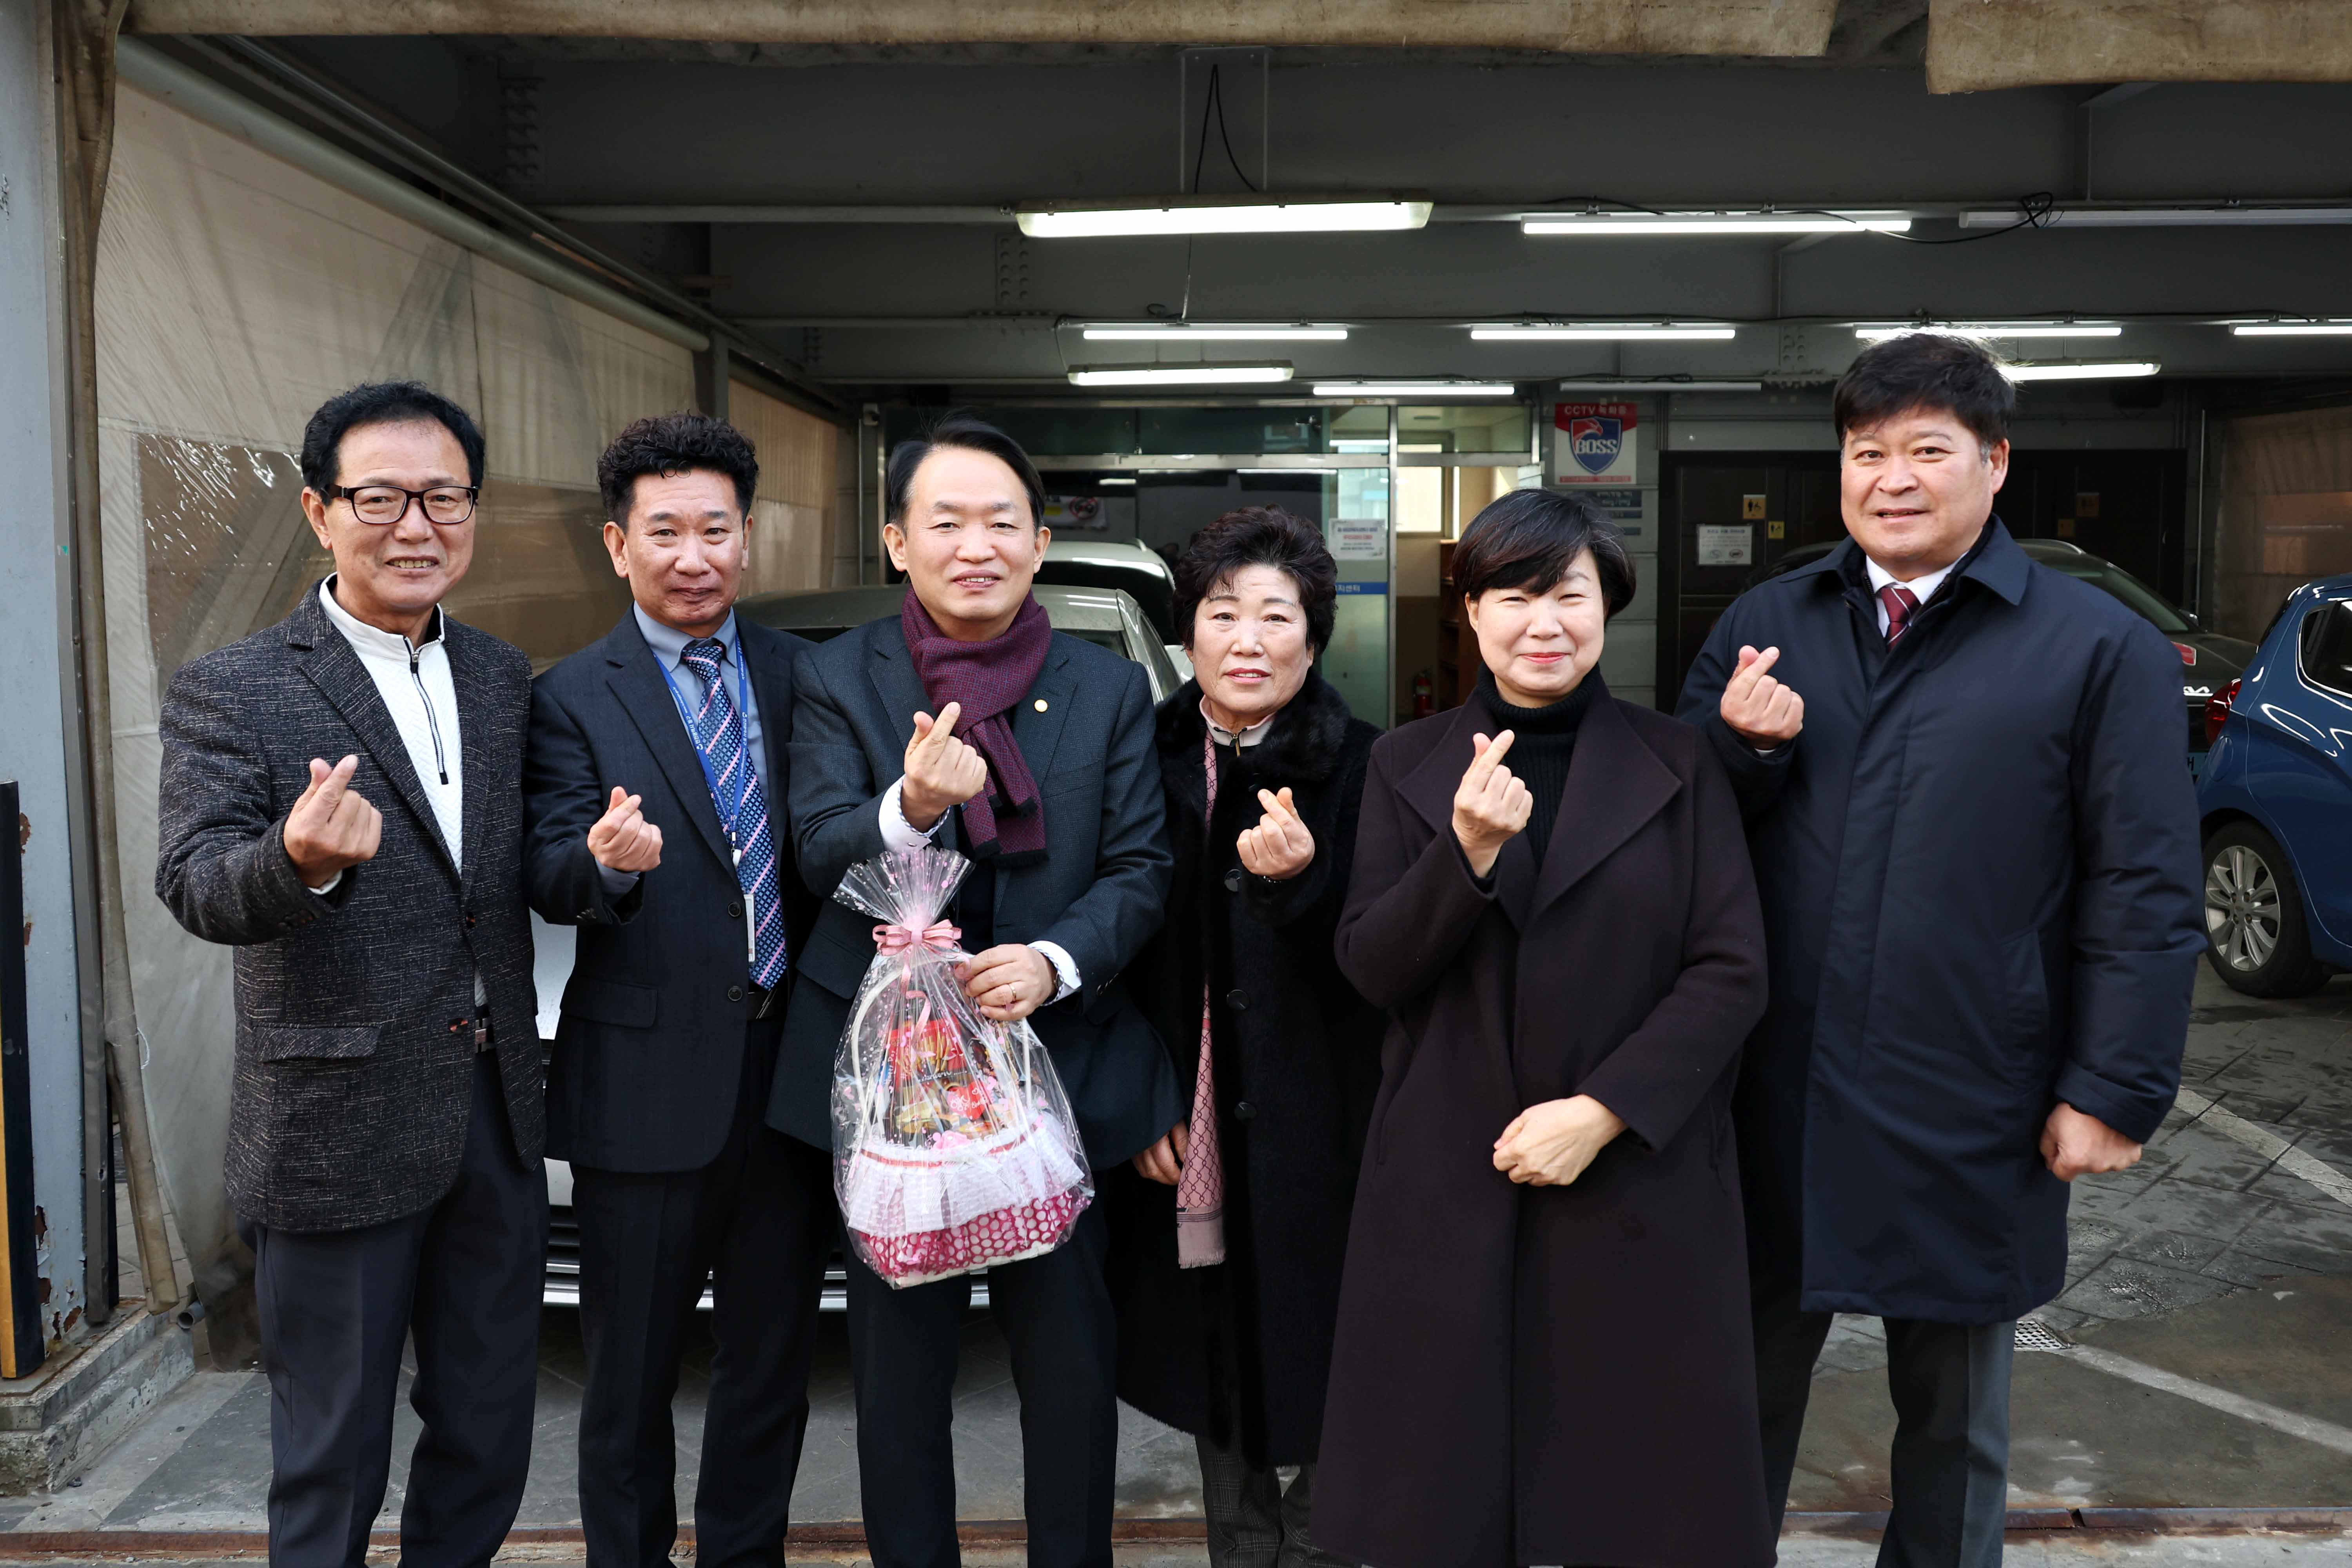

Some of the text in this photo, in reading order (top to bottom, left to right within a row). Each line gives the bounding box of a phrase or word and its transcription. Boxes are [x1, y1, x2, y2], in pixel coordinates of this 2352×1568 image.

[1564, 405, 1595, 415] CCTV
[1576, 439, 1617, 454] BOSS
[1336, 584, 1360, 593] 지센터
[686, 715, 693, 724] 동구
[689, 724, 701, 744] 인천광역시
